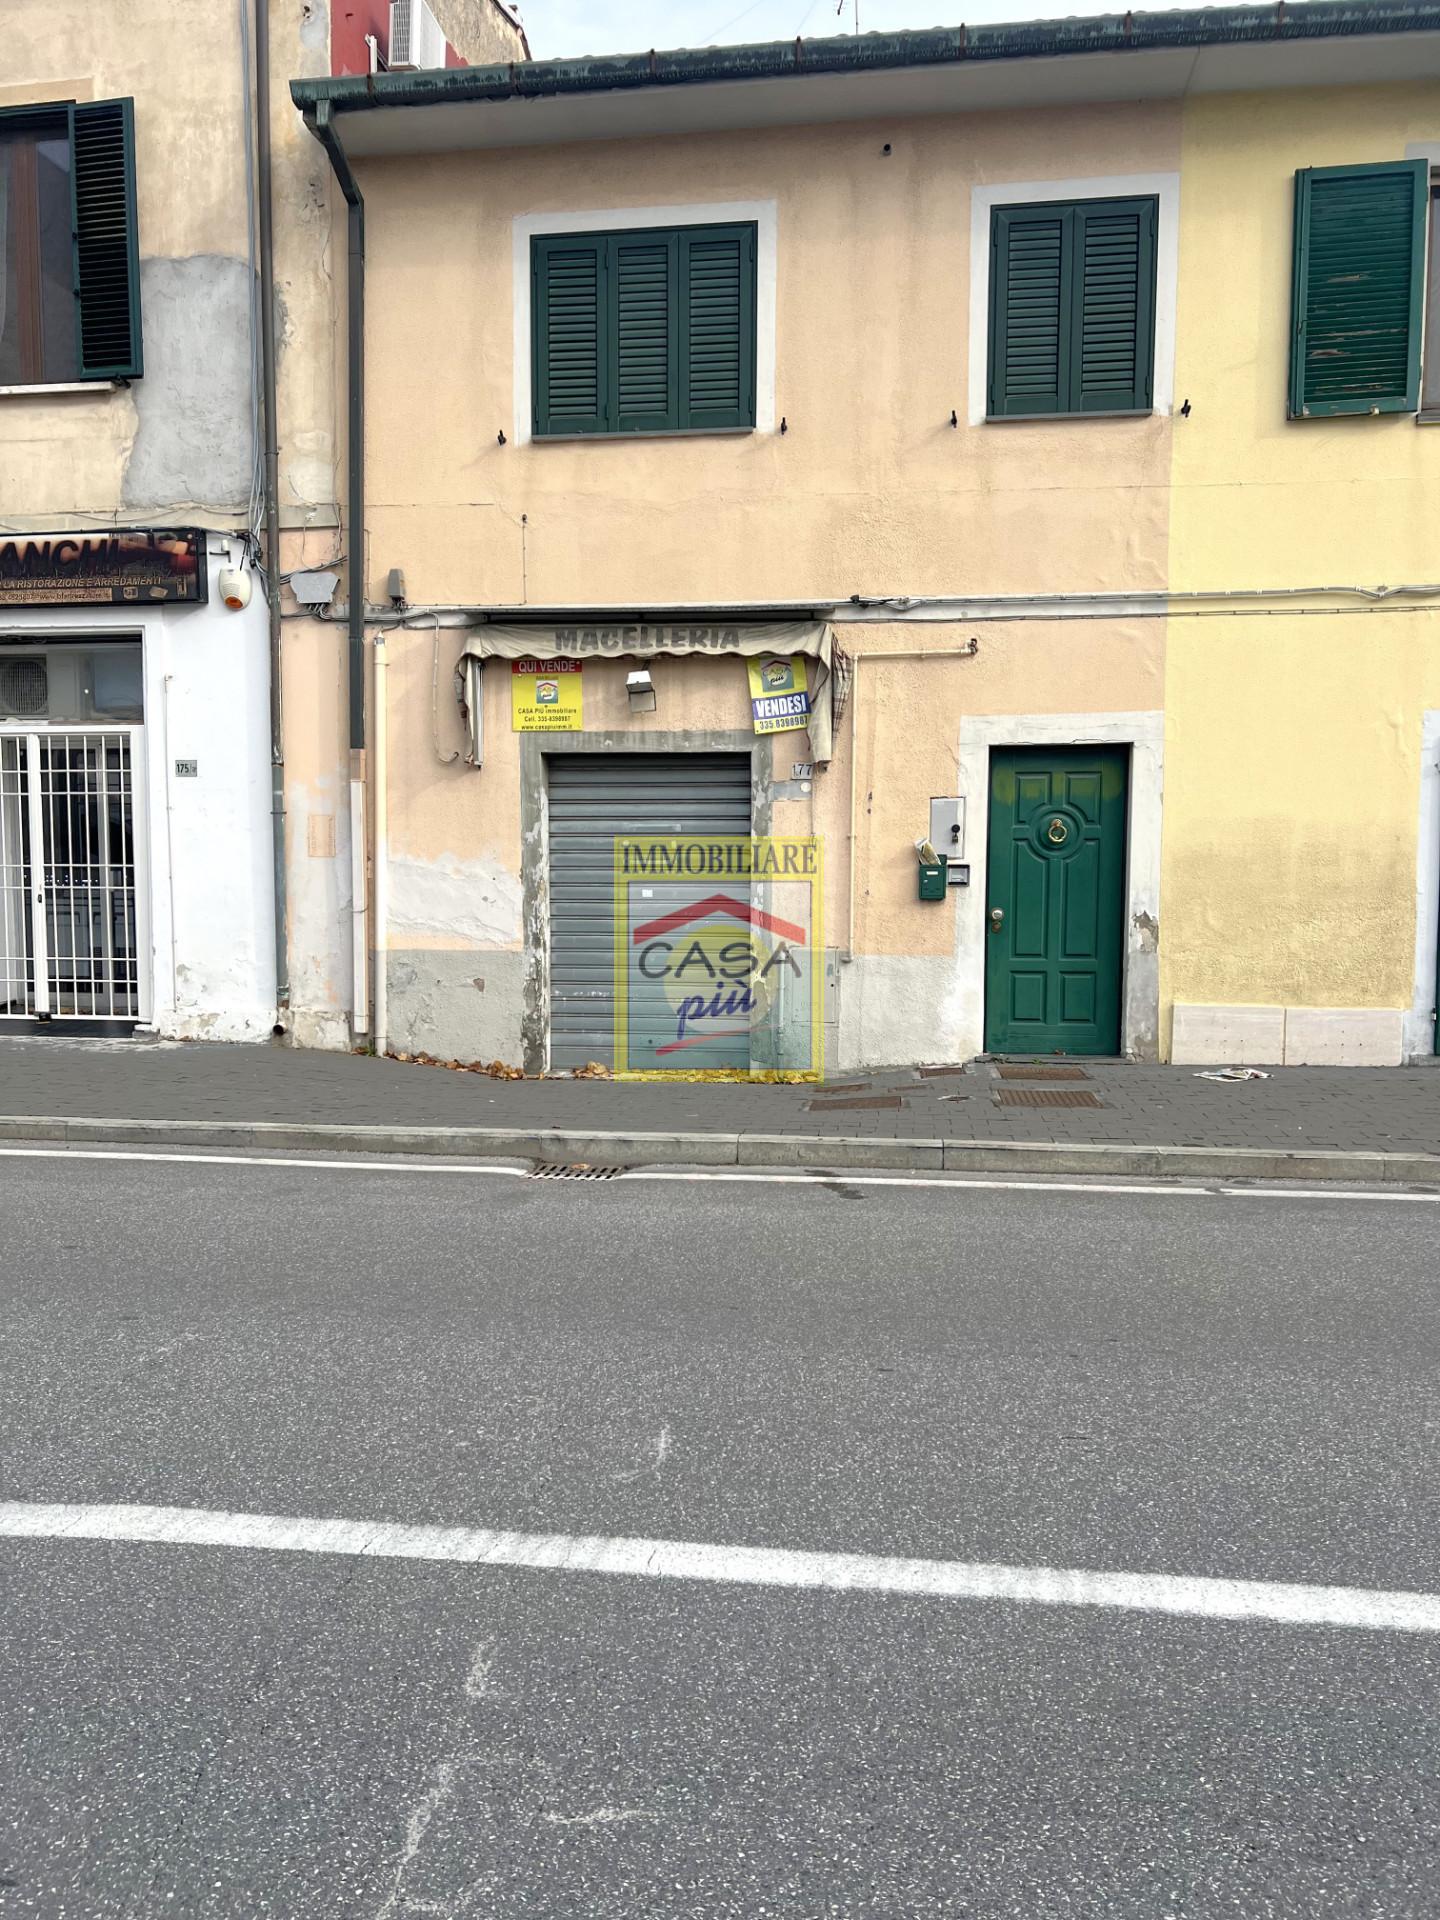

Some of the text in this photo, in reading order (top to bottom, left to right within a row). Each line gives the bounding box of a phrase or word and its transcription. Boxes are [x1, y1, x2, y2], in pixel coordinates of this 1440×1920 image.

[3, 576, 161, 589] LA RISTORAZIONE E ARREDAMENTI
[555, 626, 740, 651] MACELLERIA
[518, 661, 537, 673] QUI
[756, 694, 807, 718] VENDESI
[793, 763, 813, 776] 177
